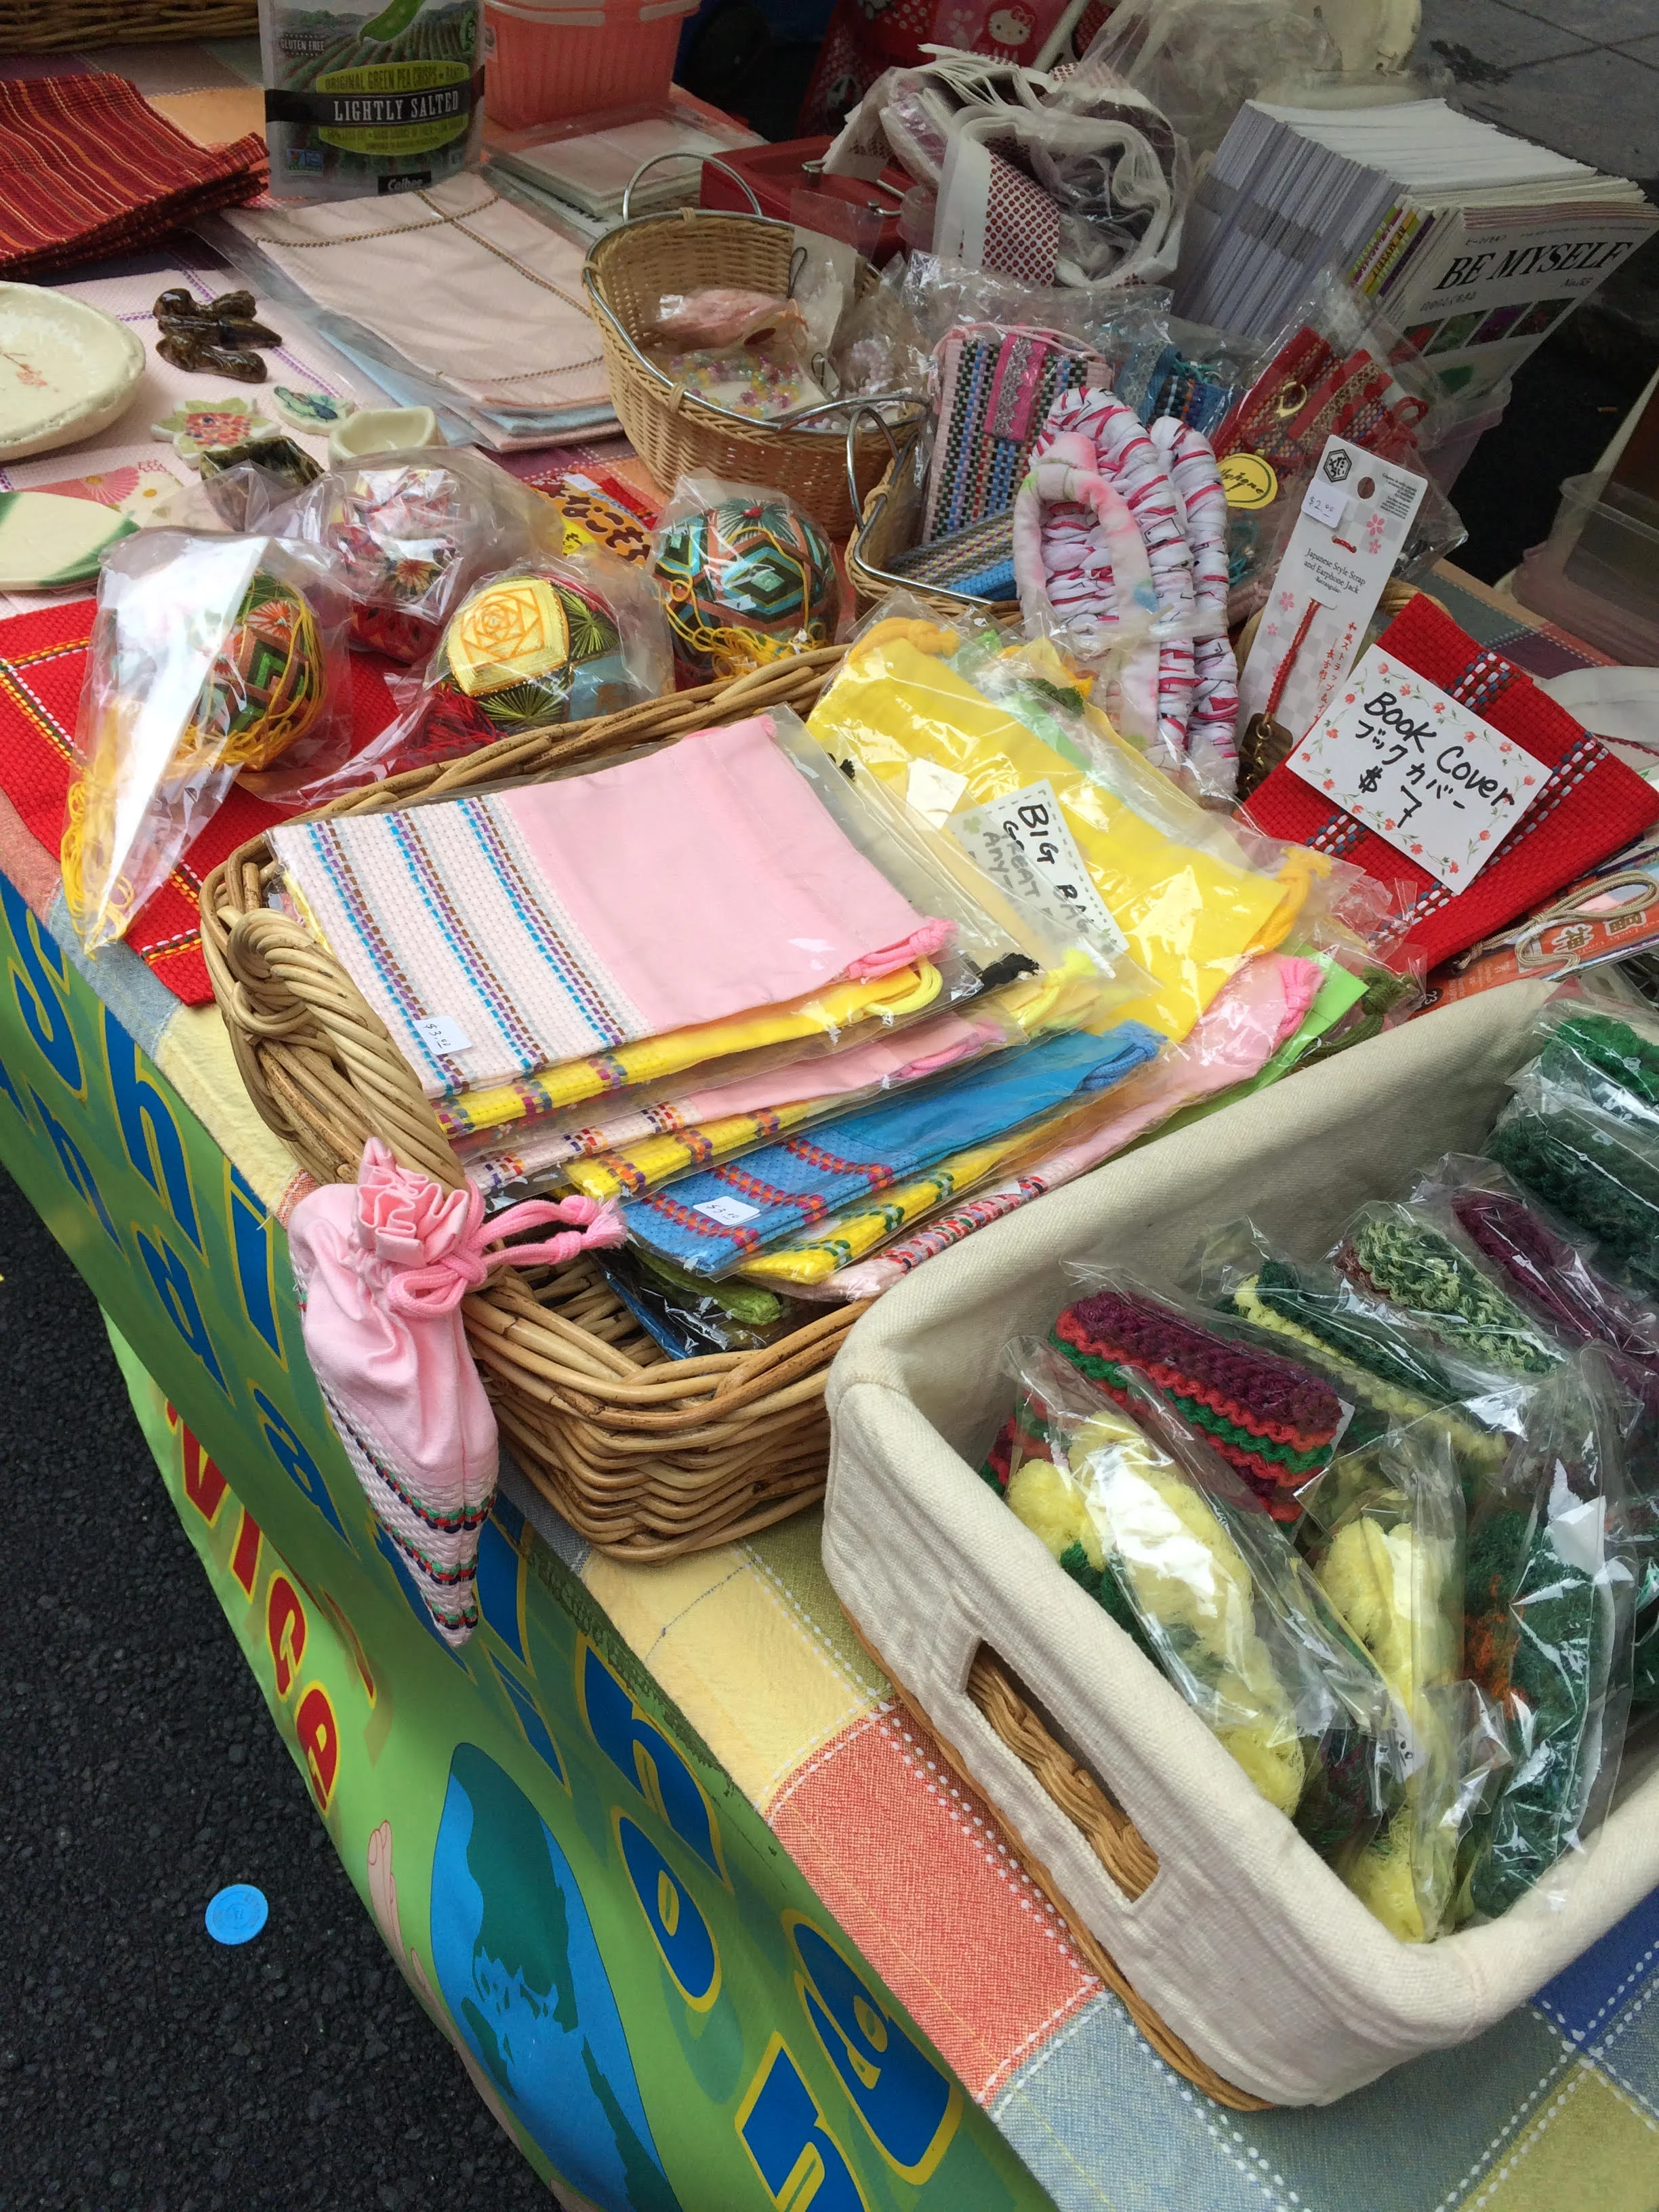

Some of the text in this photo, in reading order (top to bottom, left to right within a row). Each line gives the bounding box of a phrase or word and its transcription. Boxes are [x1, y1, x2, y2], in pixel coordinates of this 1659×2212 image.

[333, 90, 459, 121] LIGHTLY SALTED
[1433, 253, 1496, 291] BE
[1486, 241, 1633, 280] MYSELF
[1304, 548, 1332, 567] Japanese
[1304, 560, 1359, 594] and Earphone Jack
[1436, 745, 1515, 806] Cover
[1017, 803, 1059, 865] BIG
